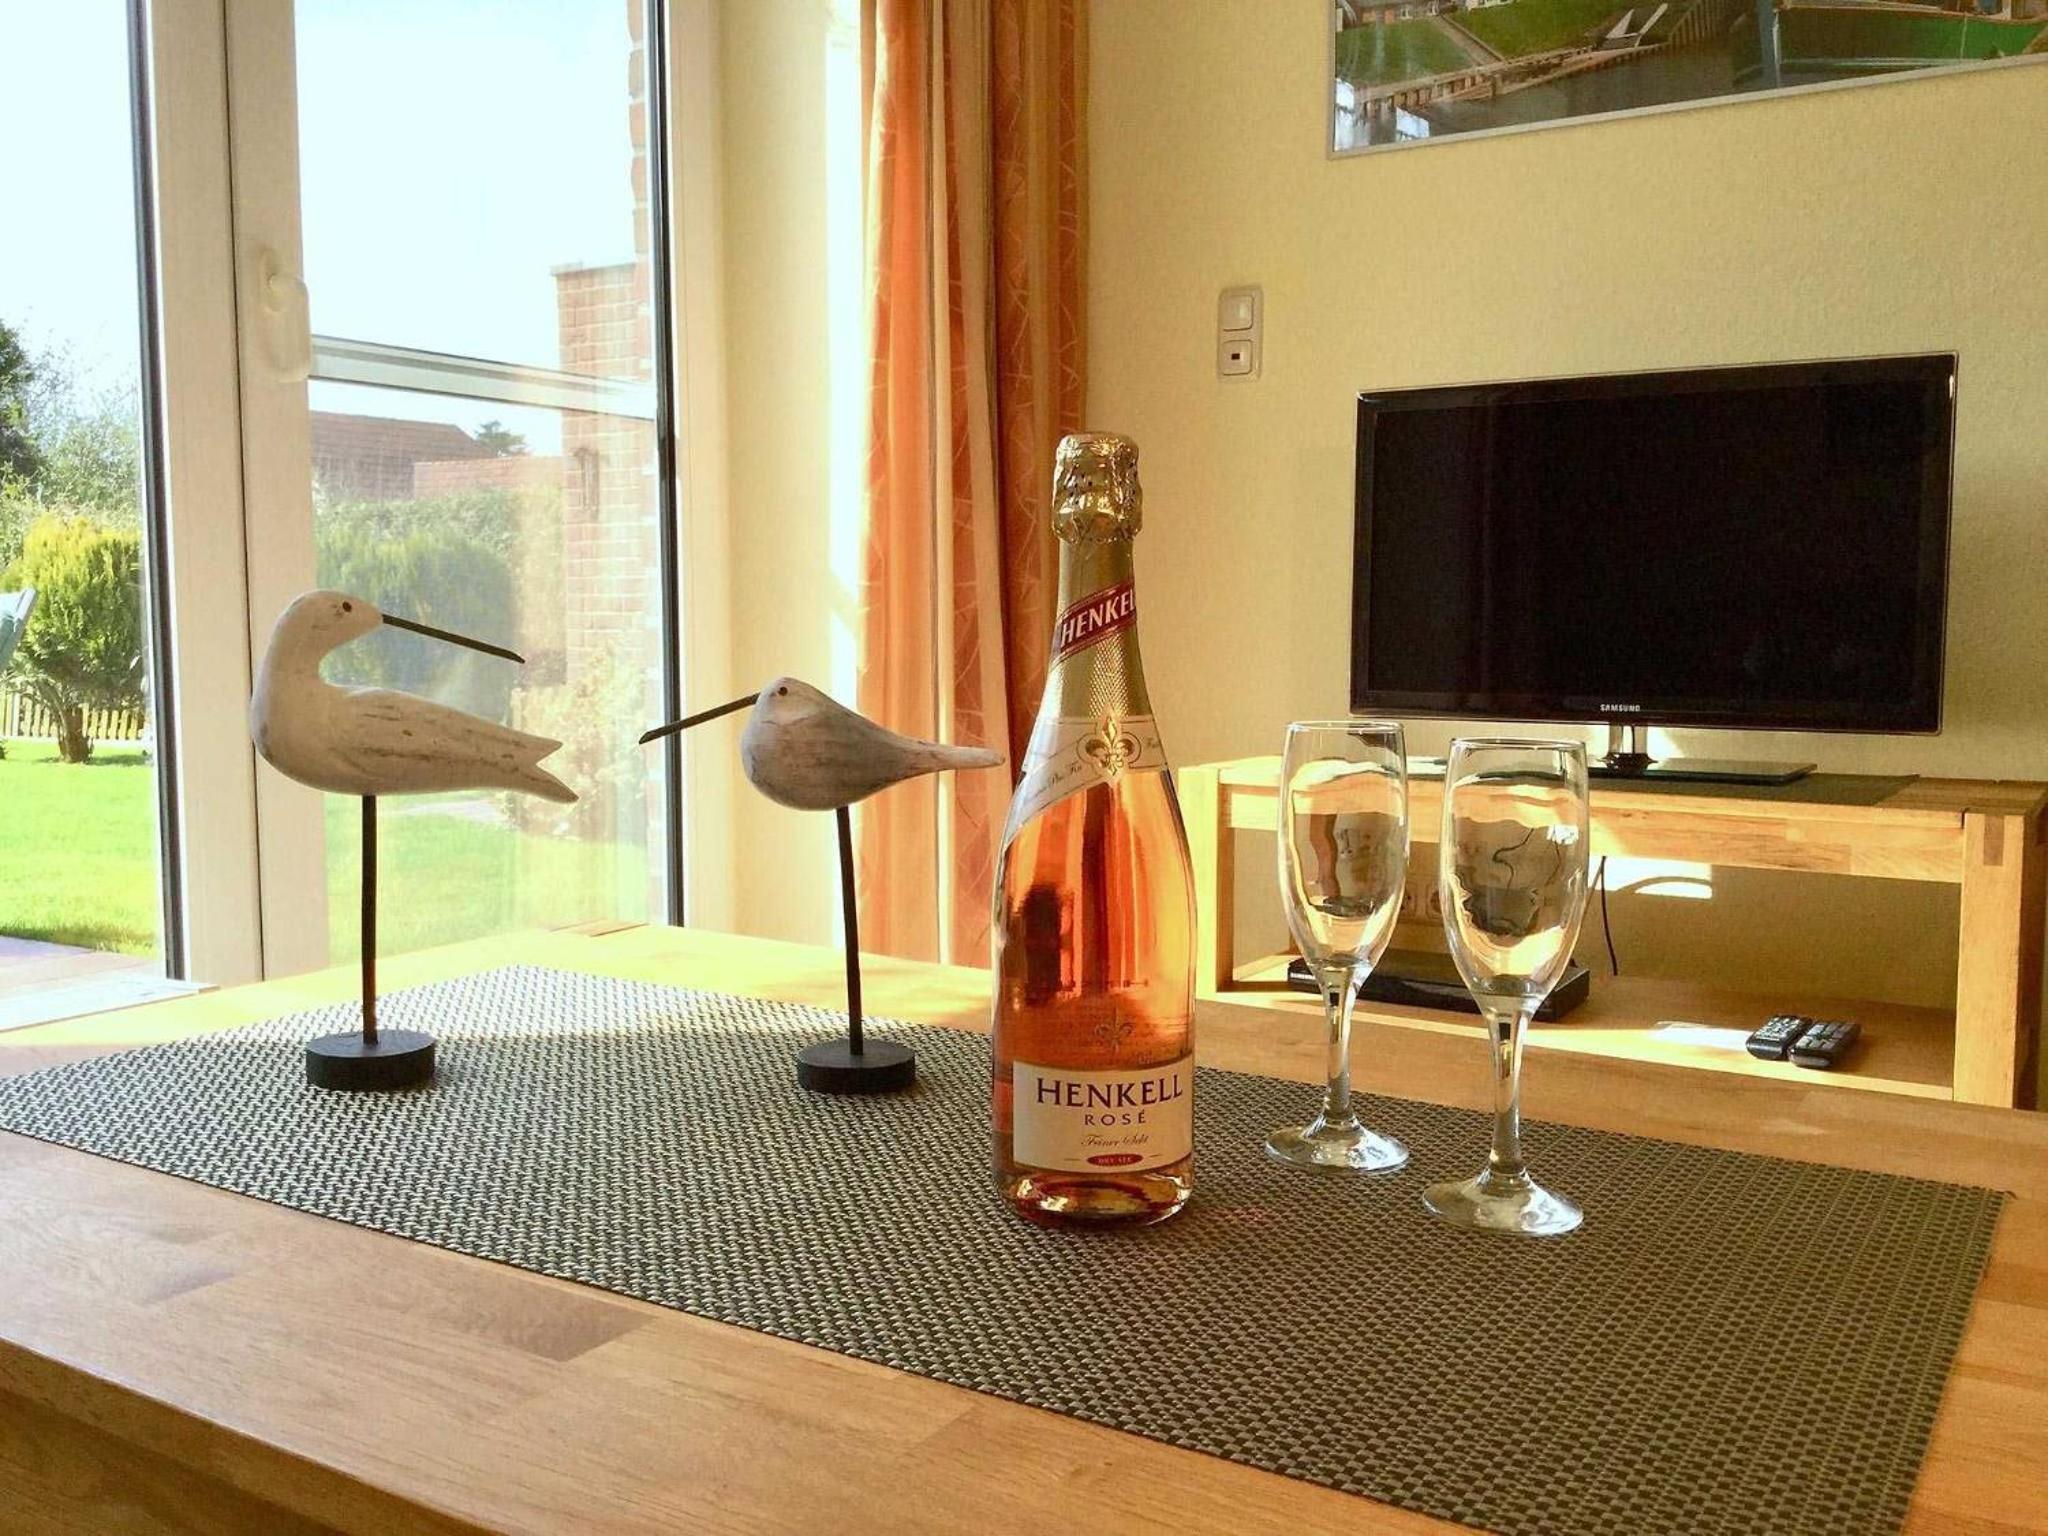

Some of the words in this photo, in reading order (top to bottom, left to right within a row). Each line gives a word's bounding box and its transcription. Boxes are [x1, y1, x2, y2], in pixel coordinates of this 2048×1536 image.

[1600, 704, 1641, 712] SAMSUNG
[1037, 1074, 1183, 1108] HENKELL
[1084, 1109, 1147, 1126] ROSÉ
